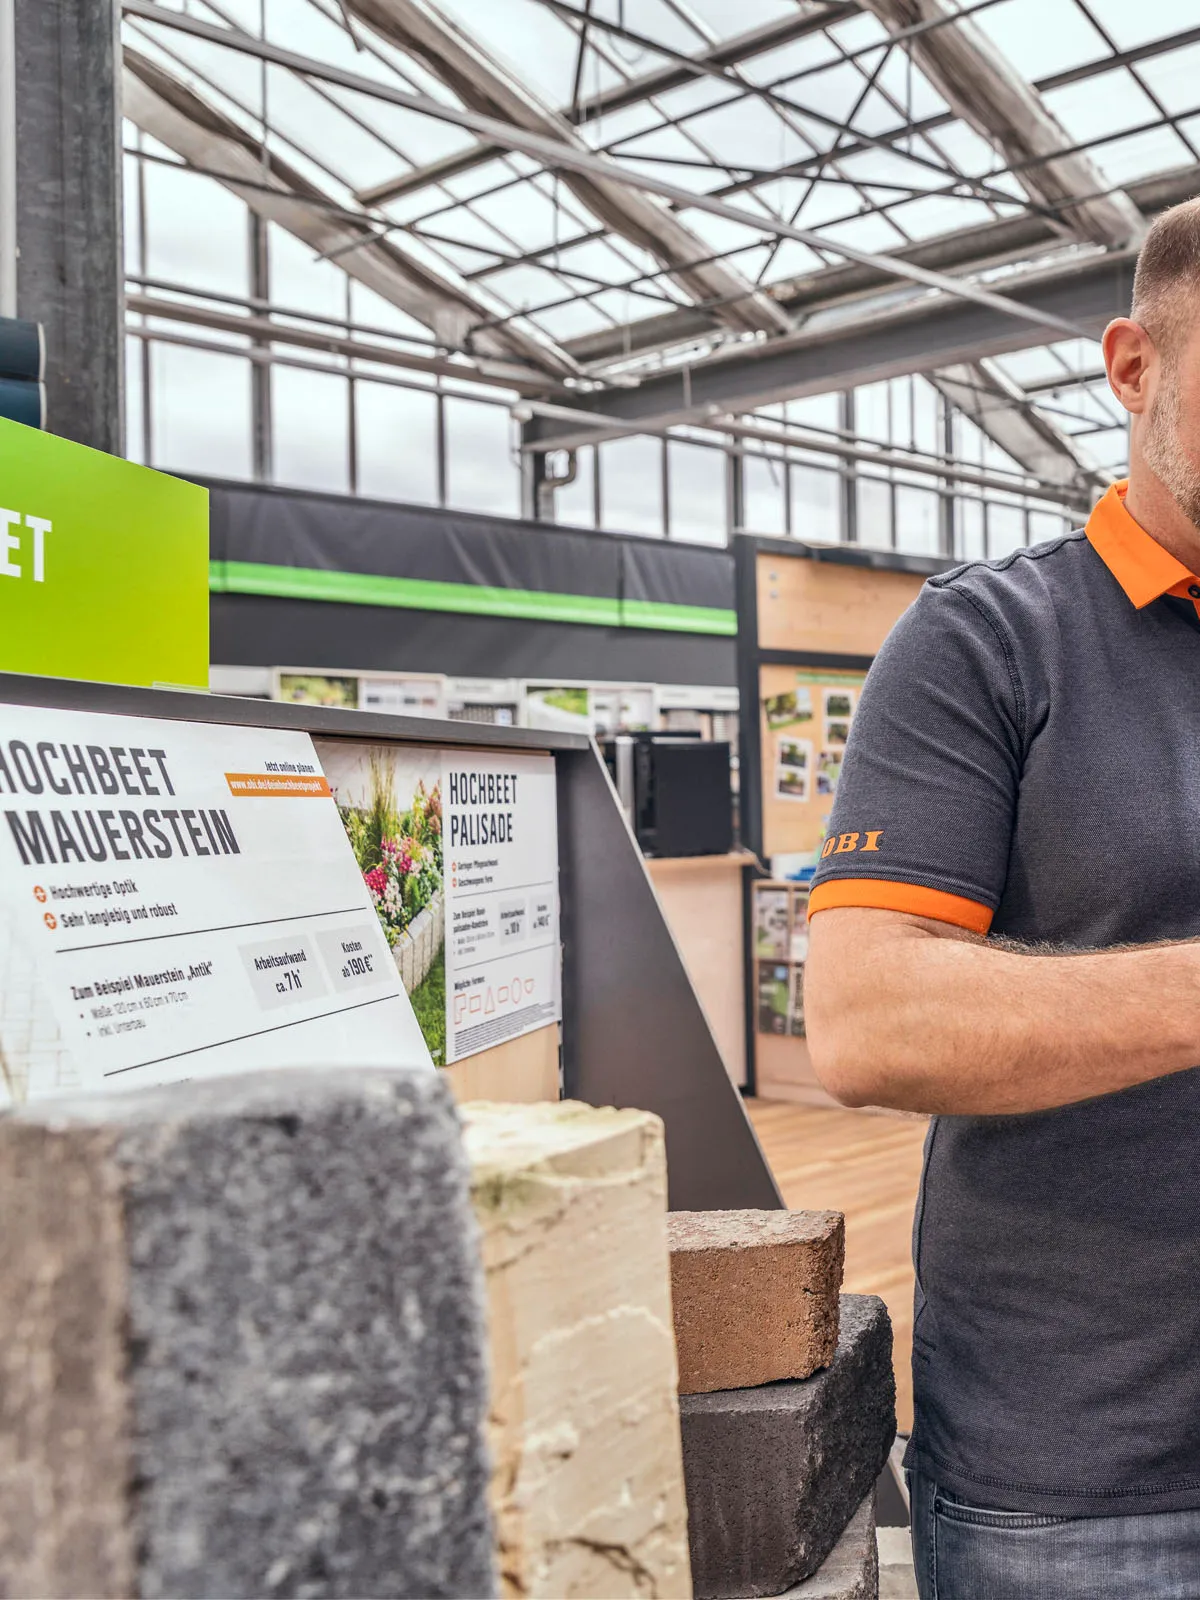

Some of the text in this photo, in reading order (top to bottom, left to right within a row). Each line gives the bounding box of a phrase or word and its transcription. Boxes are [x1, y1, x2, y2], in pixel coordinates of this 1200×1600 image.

[264, 761, 315, 774] Jetzt online planen
[450, 772, 517, 805] HOCHBEET
[4, 809, 241, 865] MAUERSTEIN
[451, 813, 513, 847] PALISADE
[821, 830, 885, 859] OBI
[49, 879, 138, 900] Hochwertige Optik
[60, 903, 178, 928] Sehr langlebig und robust
[341, 941, 363, 953] Kosten
[253, 949, 307, 970] Arbeitsaufwand
[276, 982, 288, 992] ca.
[284, 972, 293, 990] 7
[341, 966, 351, 978] ab
[70, 986, 94, 1000] Zum
[94, 976, 134, 996] Beispiel
[133, 968, 185, 989] Mauerstein
